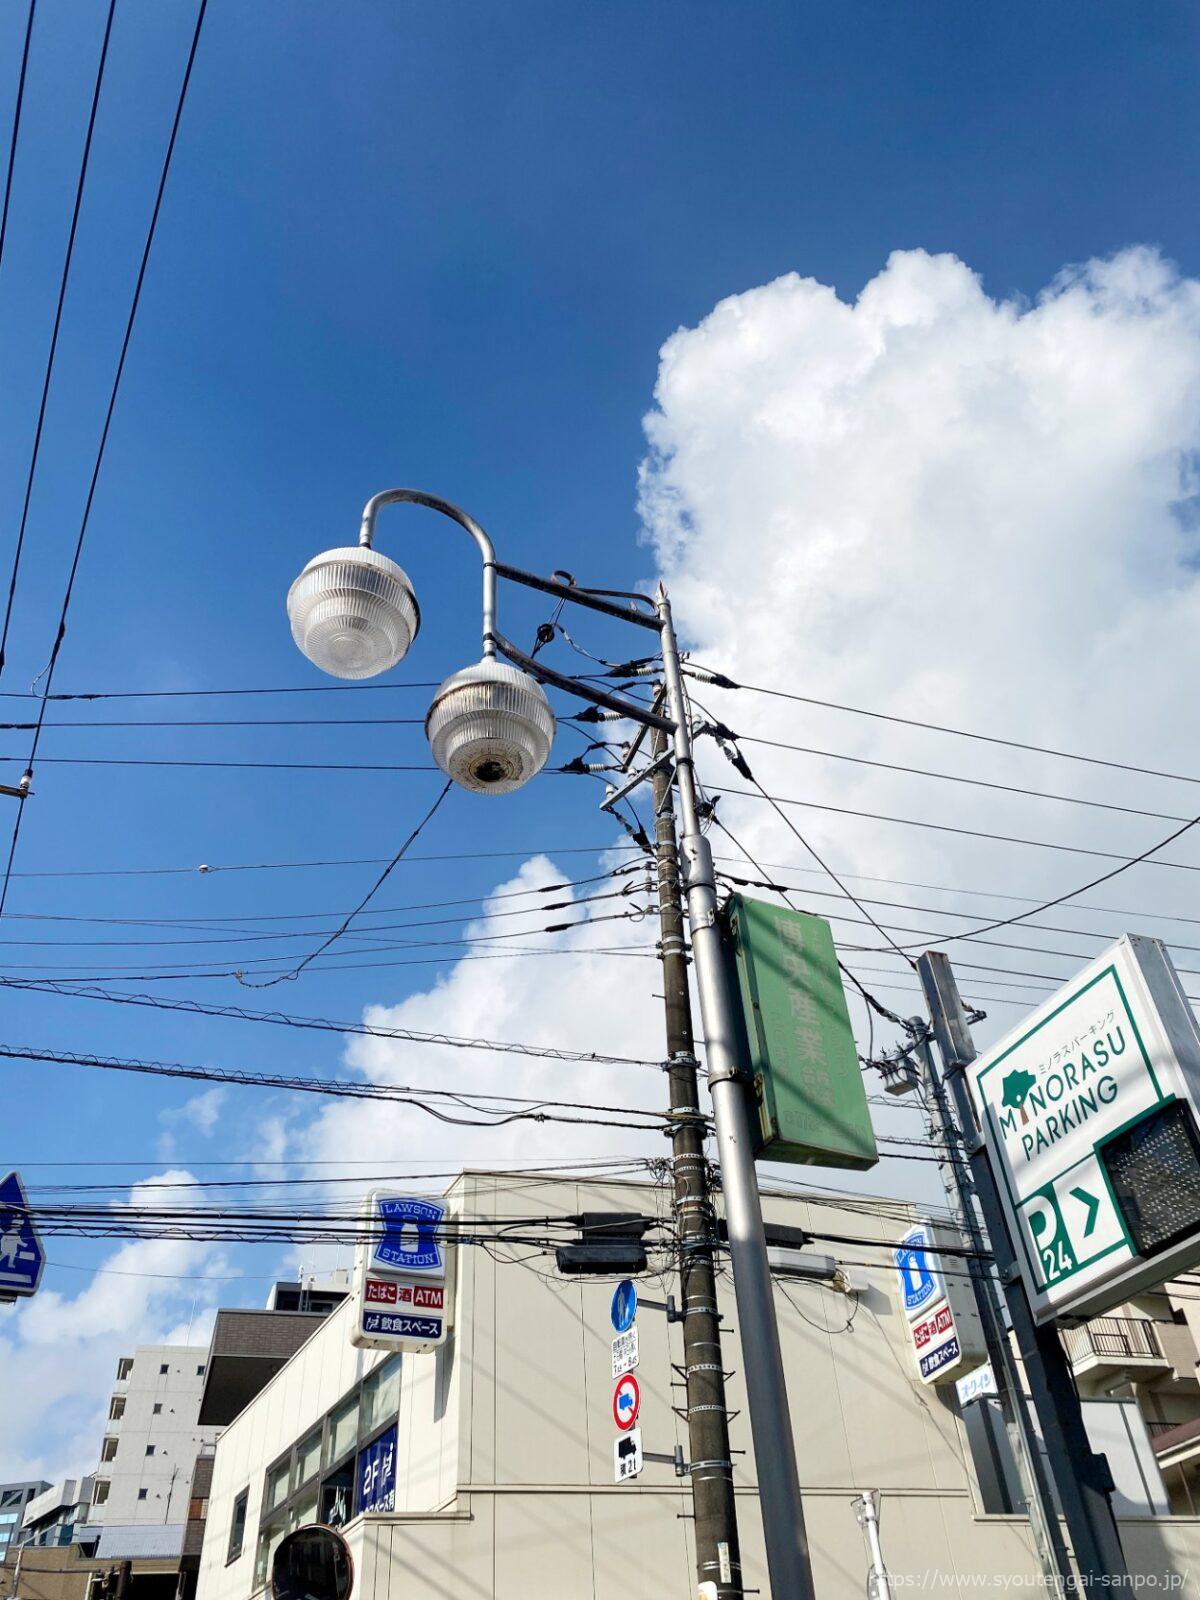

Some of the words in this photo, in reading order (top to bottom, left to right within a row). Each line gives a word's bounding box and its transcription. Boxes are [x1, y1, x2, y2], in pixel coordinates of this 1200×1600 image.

[1022, 1075, 1119, 1162] PARKING
[384, 1203, 438, 1219] LAWSON
[382, 1248, 434, 1264] STATION
[1043, 1240, 1073, 1280] 24
[368, 1284, 396, 1300] たばこ
[415, 1289, 442, 1305] ATM
[907, 1279, 933, 1305] STATION
[381, 1316, 439, 1335] 飲食スペース
[938, 1310, 952, 1329] ATM
[363, 1459, 380, 1496] 2F
